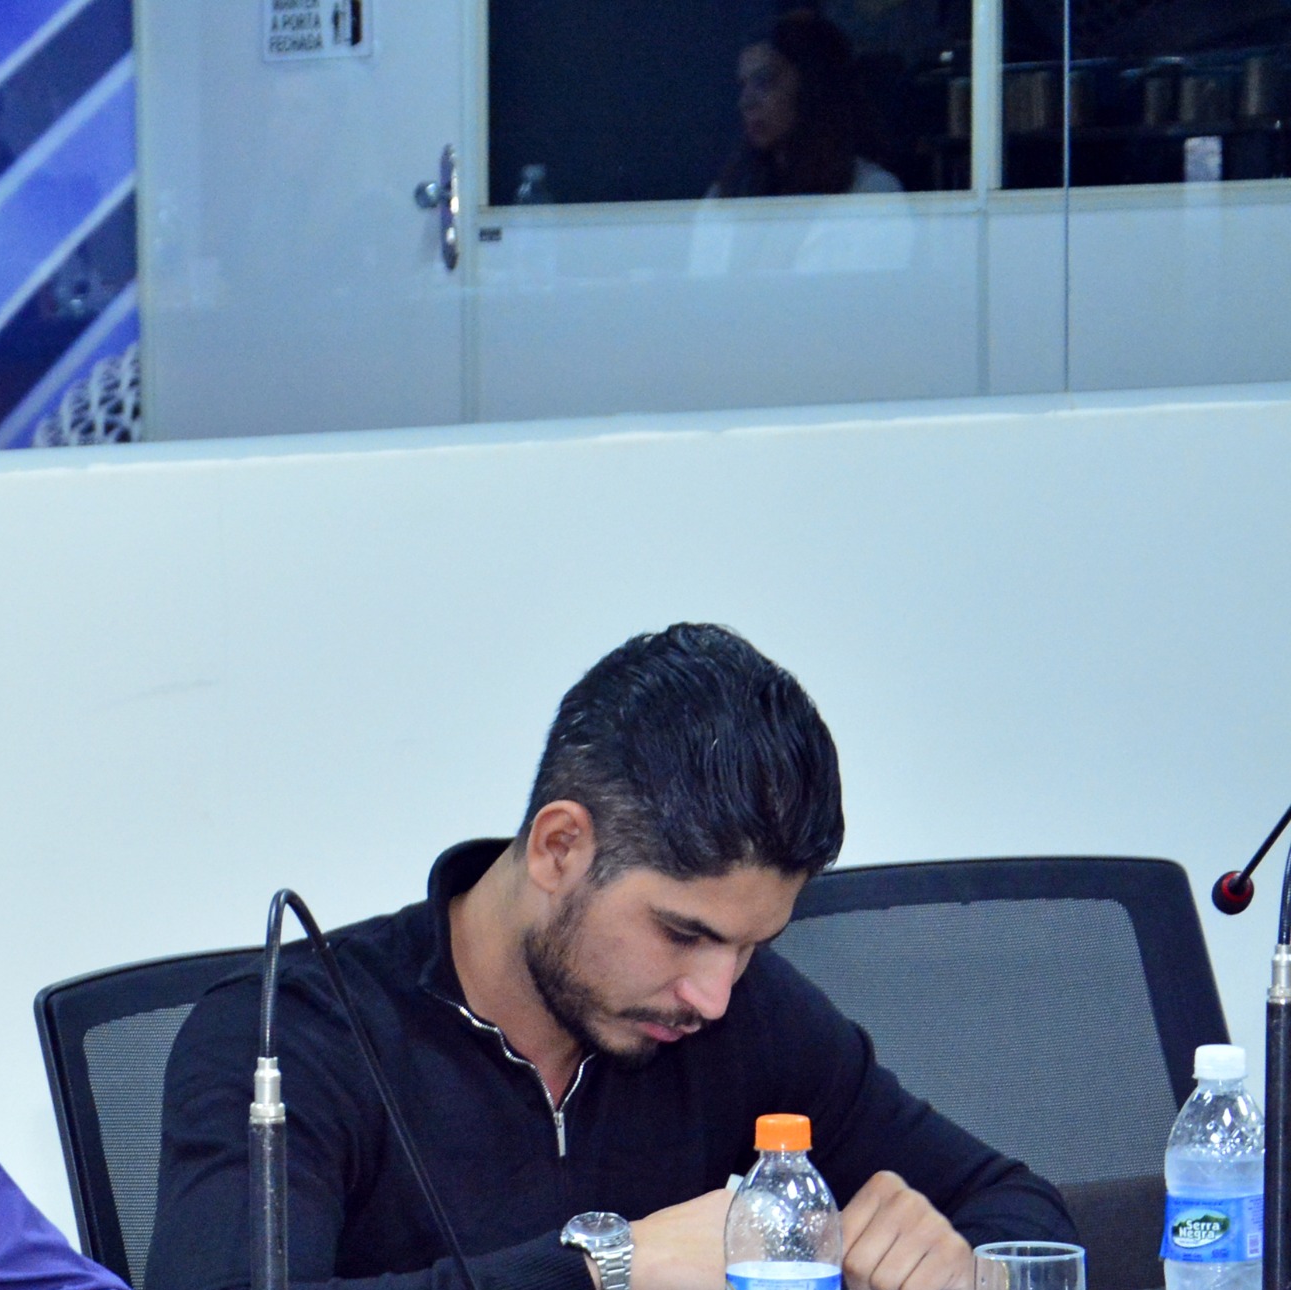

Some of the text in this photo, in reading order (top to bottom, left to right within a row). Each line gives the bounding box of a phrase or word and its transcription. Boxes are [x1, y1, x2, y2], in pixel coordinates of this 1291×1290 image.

[282, 12, 322, 31] PORTA
[268, 34, 324, 52] FECHADA
[1179, 1226, 1216, 1239] Negra
[1186, 1220, 1220, 1231] Serra
